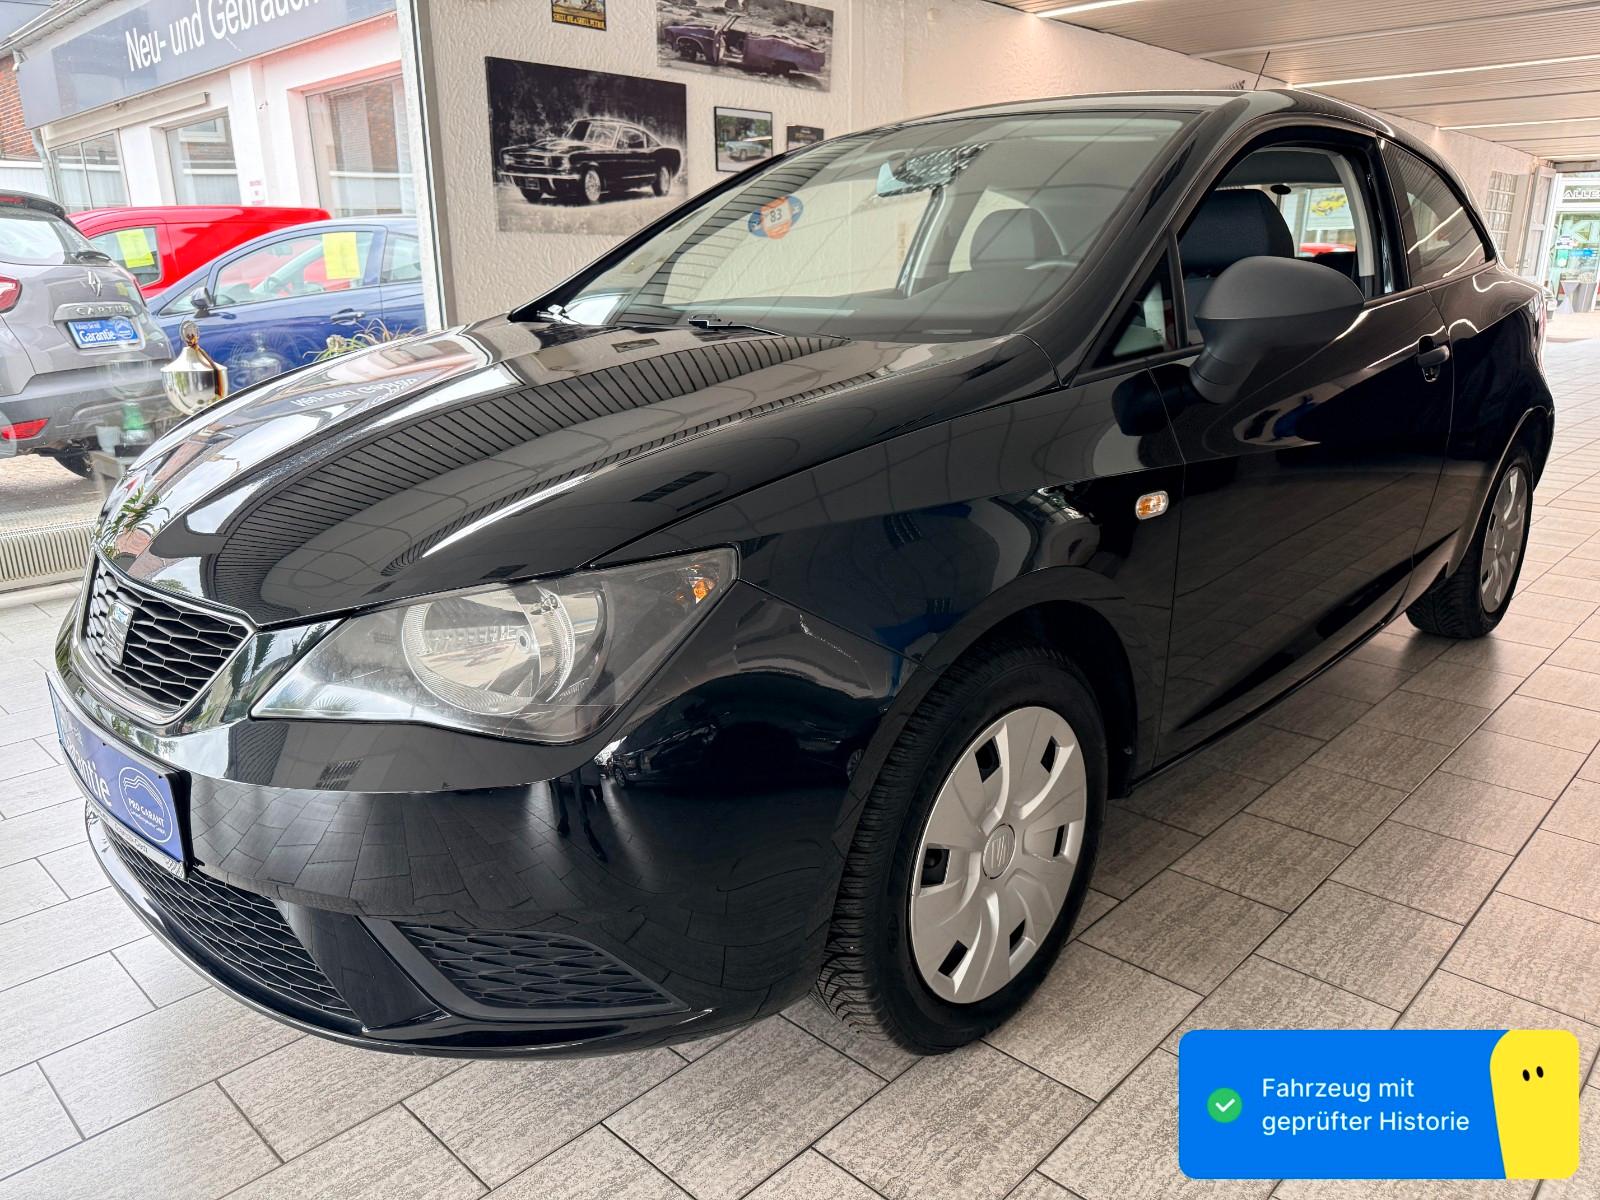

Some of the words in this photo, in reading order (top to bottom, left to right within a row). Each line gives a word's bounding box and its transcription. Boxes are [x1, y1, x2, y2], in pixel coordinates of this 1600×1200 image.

[125, 28, 167, 71] Neu-
[169, 0, 205, 56] und
[208, 0, 319, 39] Gebrau
[770, 208, 782, 223] 83
[80, 328, 117, 343] Garantie
[128, 797, 140, 812] PRO
[140, 806, 165, 828] GARANT
